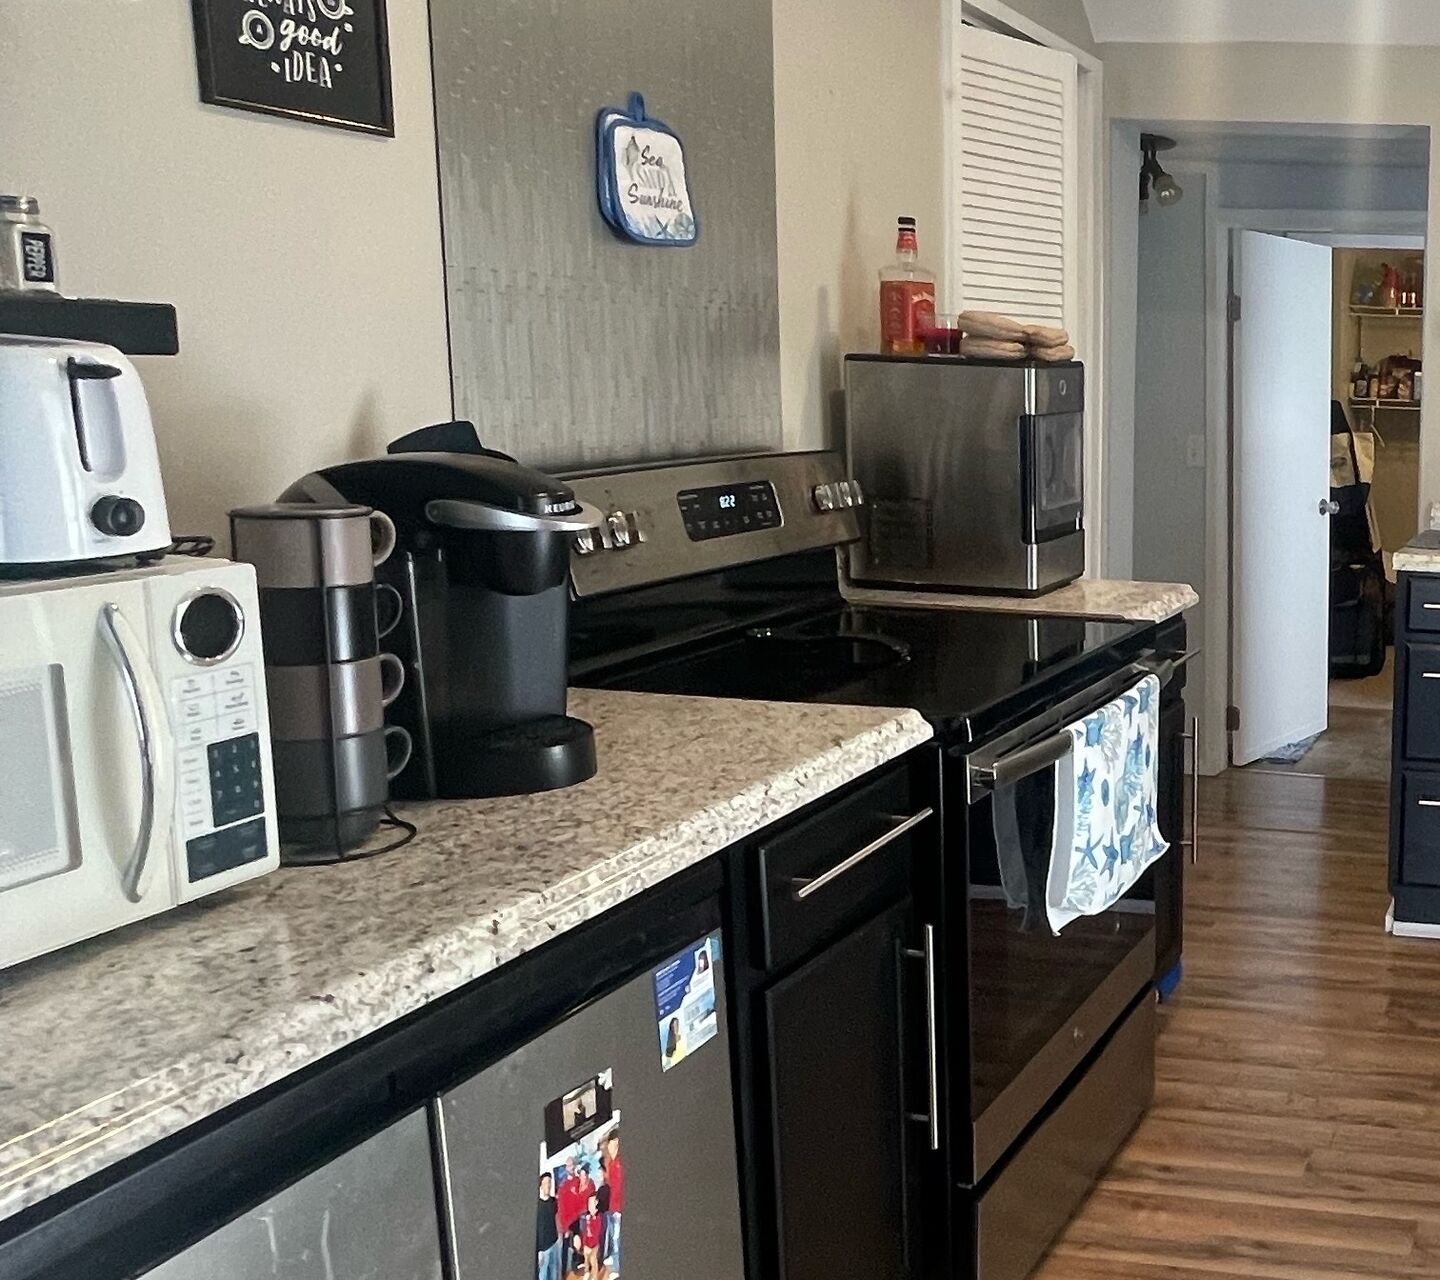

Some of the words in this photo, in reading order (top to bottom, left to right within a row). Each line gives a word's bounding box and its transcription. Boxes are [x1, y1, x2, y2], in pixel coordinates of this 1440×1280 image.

[280, 19, 342, 55] good
[284, 50, 333, 89] IDEA
[641, 145, 663, 167] Sea
[628, 183, 683, 212] Sunshine
